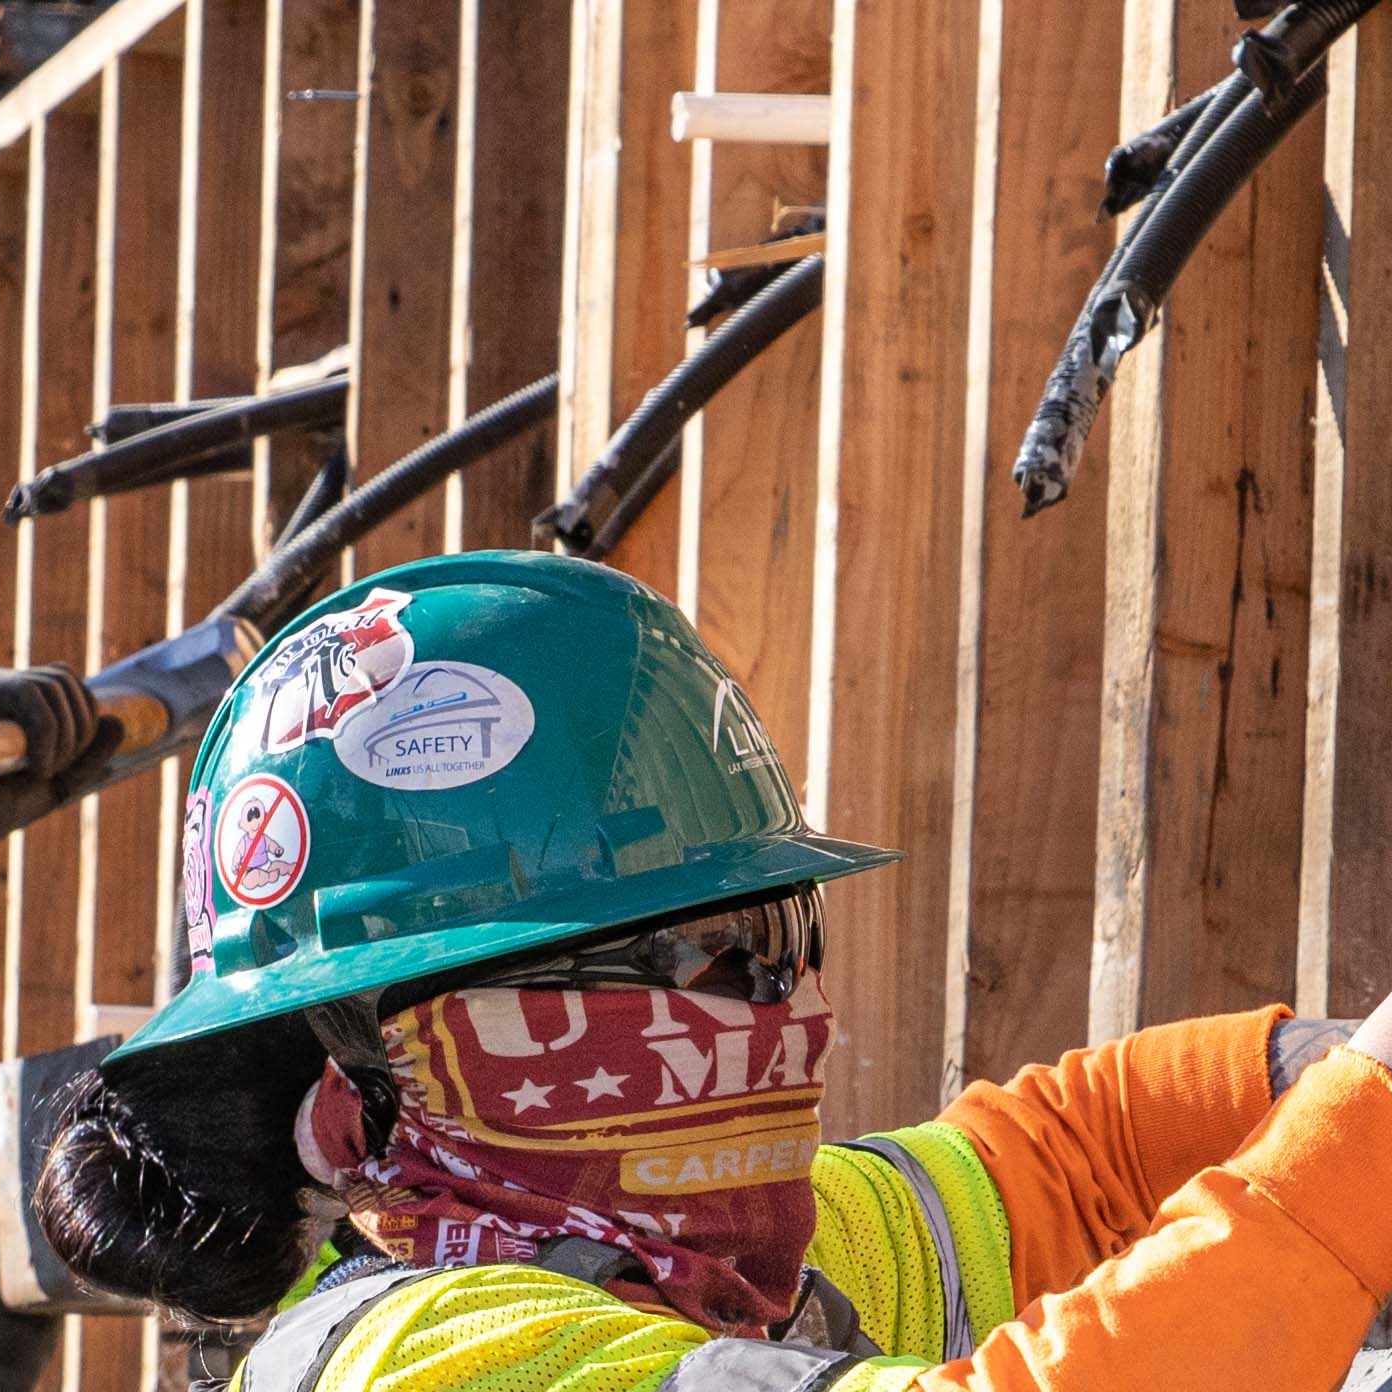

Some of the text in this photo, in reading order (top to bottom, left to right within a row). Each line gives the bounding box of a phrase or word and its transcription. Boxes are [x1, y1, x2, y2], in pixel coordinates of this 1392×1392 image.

[395, 735, 473, 757] SAFETY
[385, 761, 486, 778] LINXS US ALL TOGETHER
